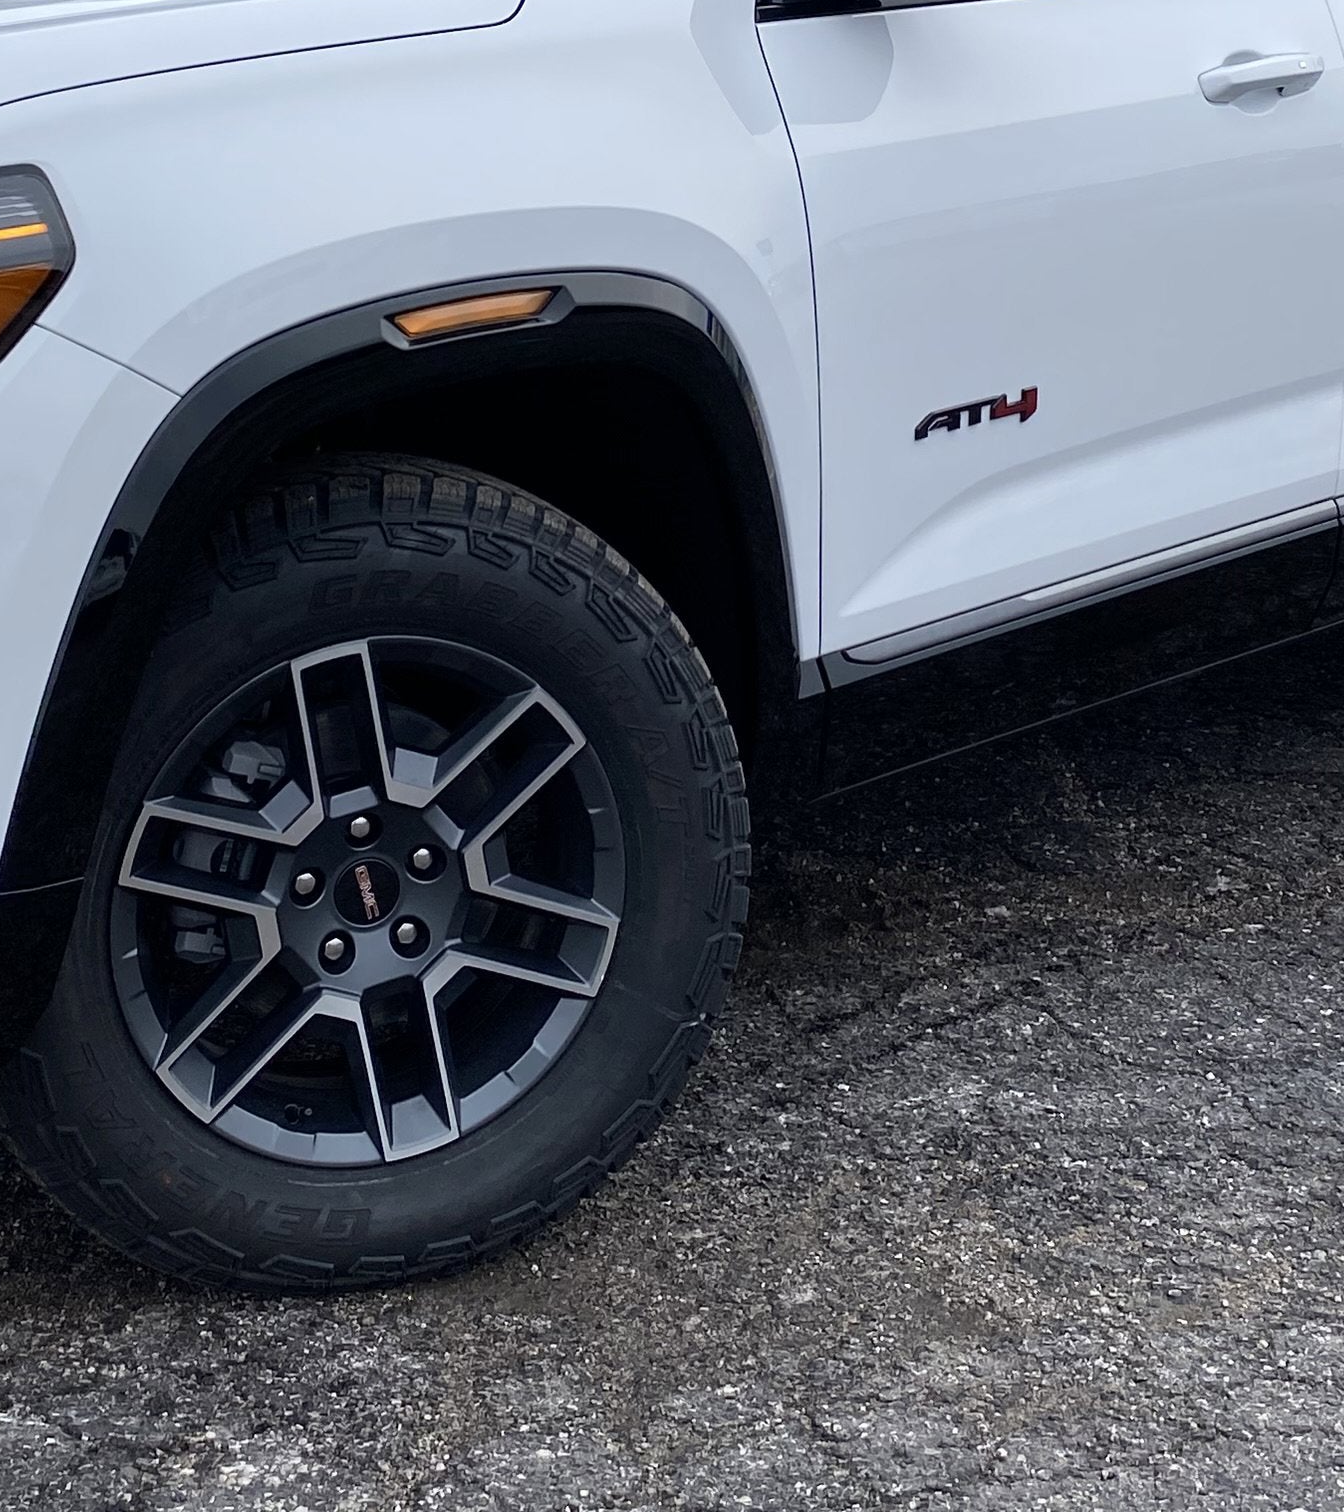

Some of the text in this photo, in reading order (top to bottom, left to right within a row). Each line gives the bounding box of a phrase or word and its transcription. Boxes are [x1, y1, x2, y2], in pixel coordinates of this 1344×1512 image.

[914, 385, 1038, 441] AT4
[308, 568, 641, 708] GRABBER
[355, 865, 379, 920] GMC
[62, 1041, 372, 1245] GENERAL
